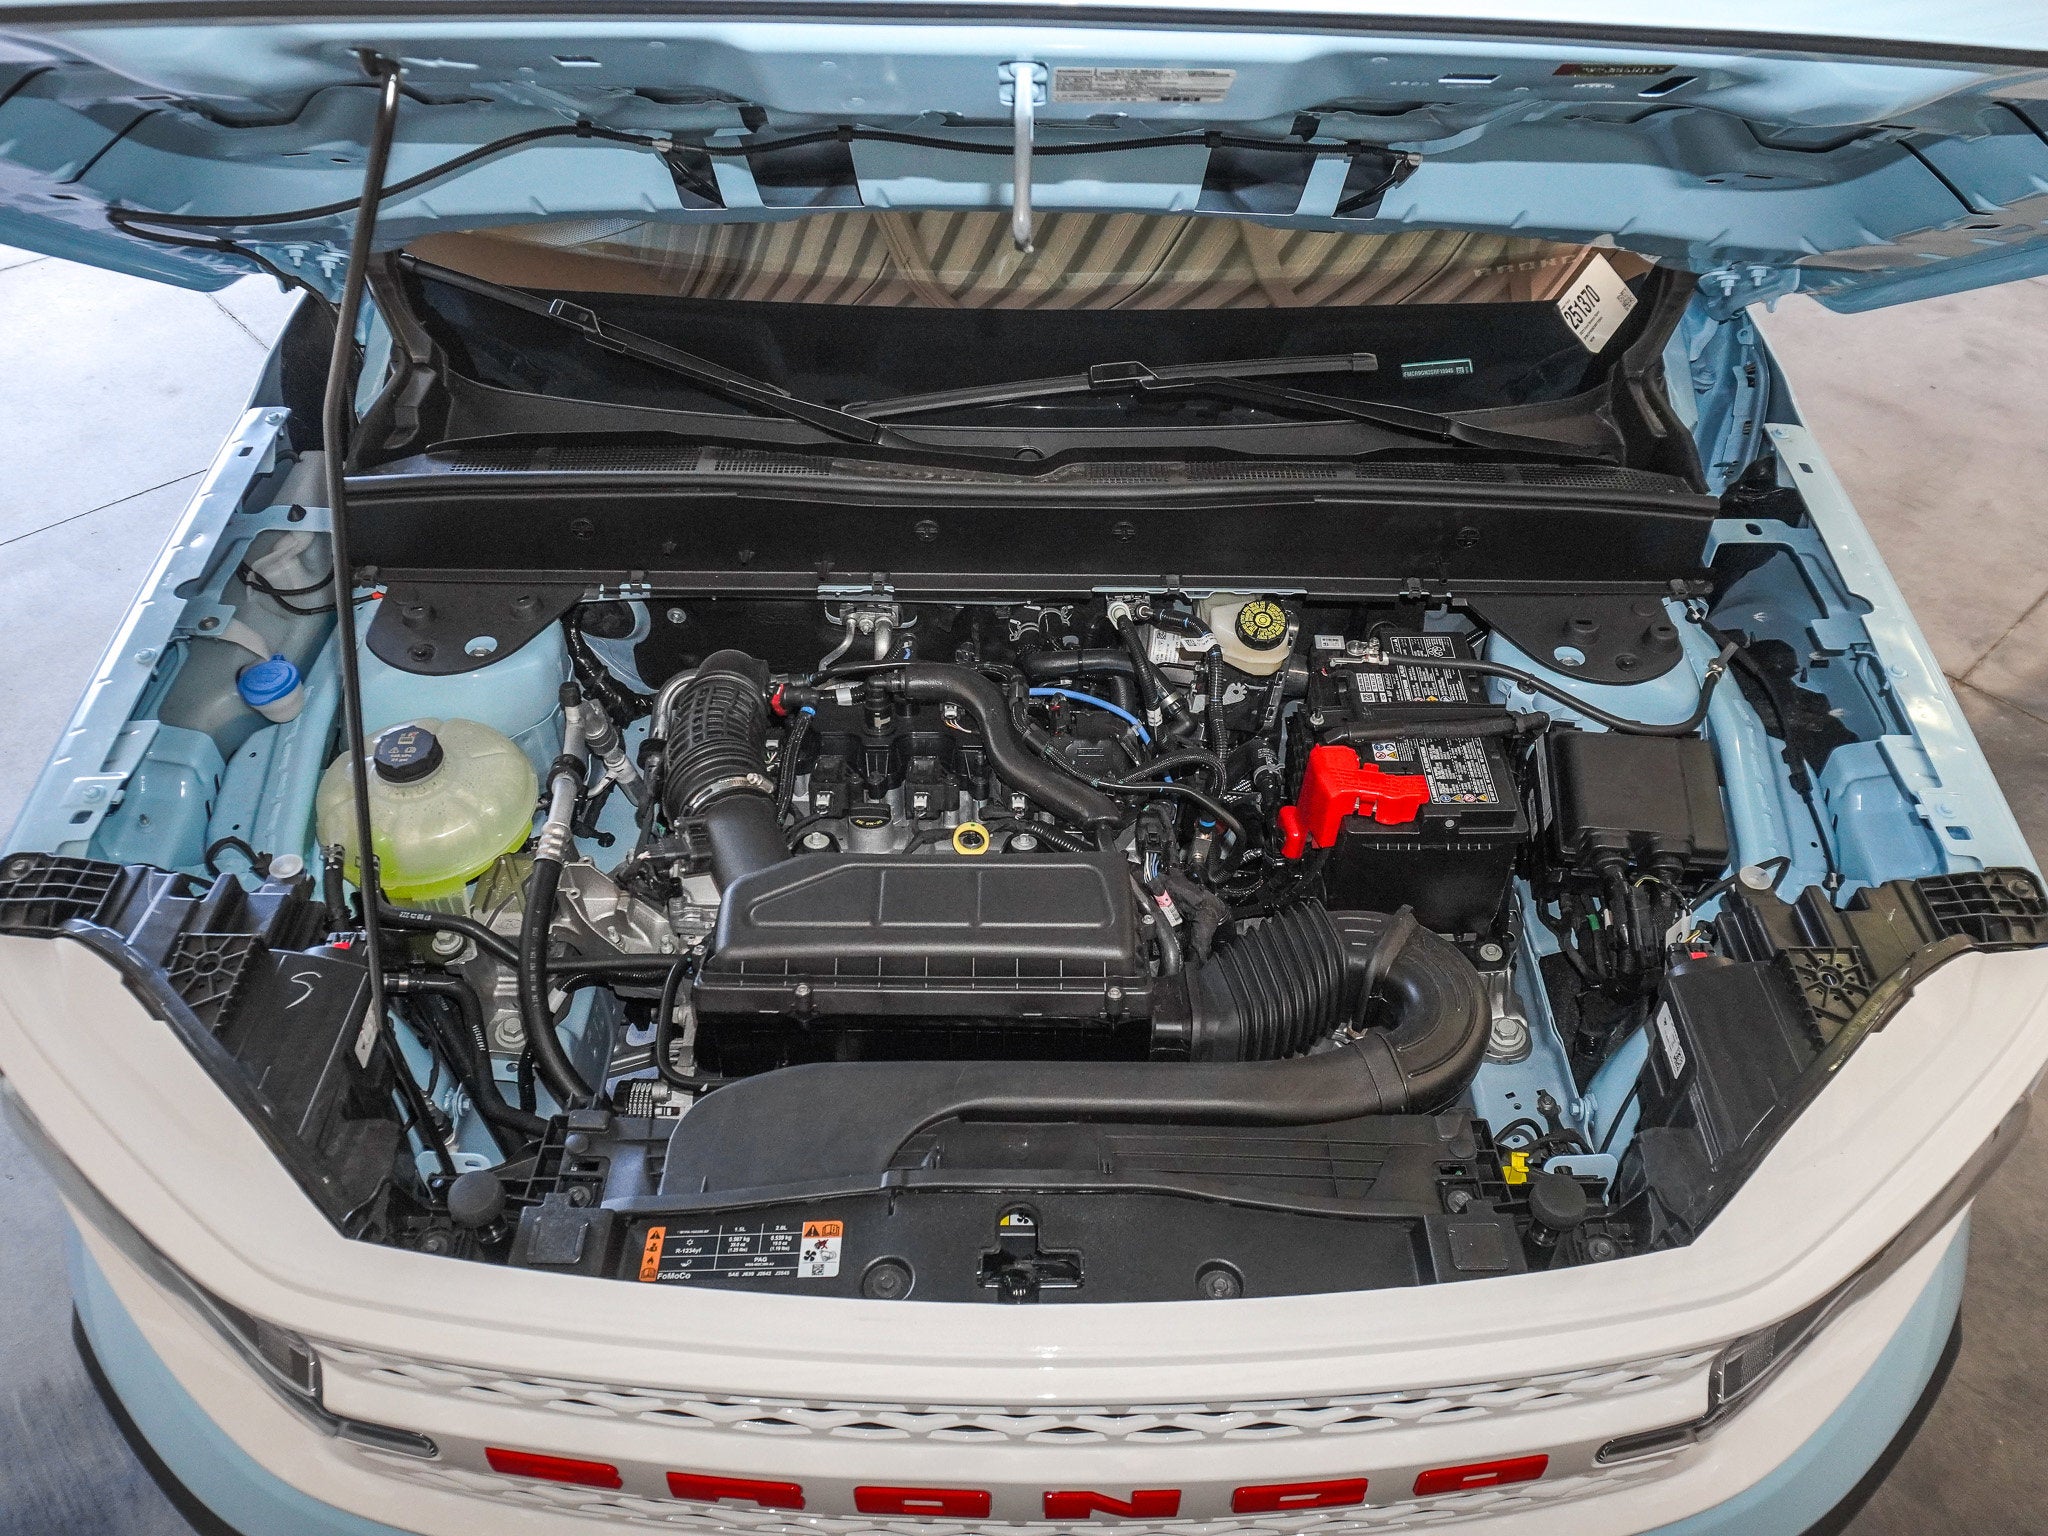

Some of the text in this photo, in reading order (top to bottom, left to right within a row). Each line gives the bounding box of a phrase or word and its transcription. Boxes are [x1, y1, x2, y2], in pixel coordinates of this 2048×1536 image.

[1564, 285, 1600, 329] 251370
[285, 971, 323, 1010] S
[657, 1272, 691, 1280] FoMoCo
